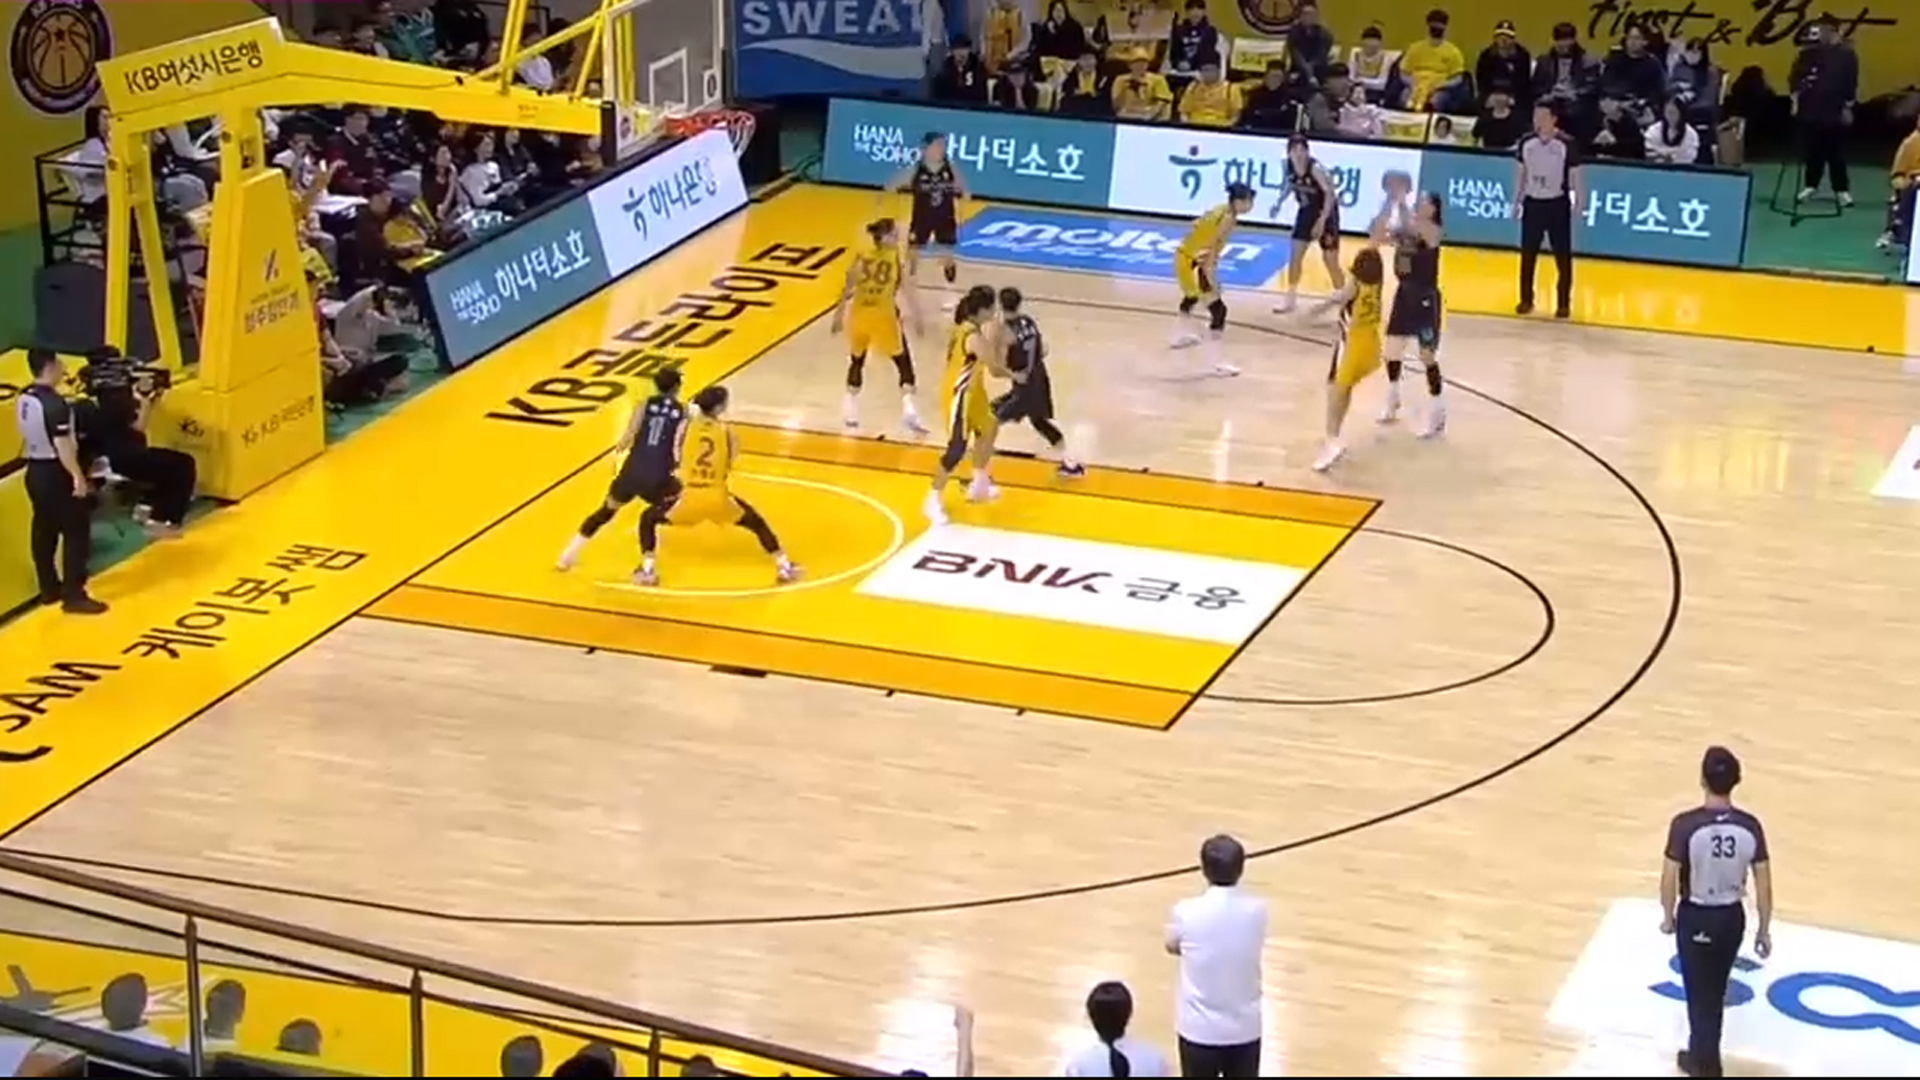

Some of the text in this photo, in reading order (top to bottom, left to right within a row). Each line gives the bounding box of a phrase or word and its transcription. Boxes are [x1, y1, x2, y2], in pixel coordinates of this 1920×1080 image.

[124, 40, 263, 94] KB여섯시은행
[853, 124, 904, 146] HANA
[871, 144, 922, 168] SOHO
[1224, 159, 1361, 208] 하나행
[1449, 178, 1505, 199] HANA
[1569, 190, 1711, 238] 나더소호
[696, 437, 715, 467] 2
[912, 550, 1247, 610] BNK 금융
[121, 576, 316, 660] 케이봇
[265, 543, 370, 573] 쌤
[1711, 835, 1736, 859] 33
